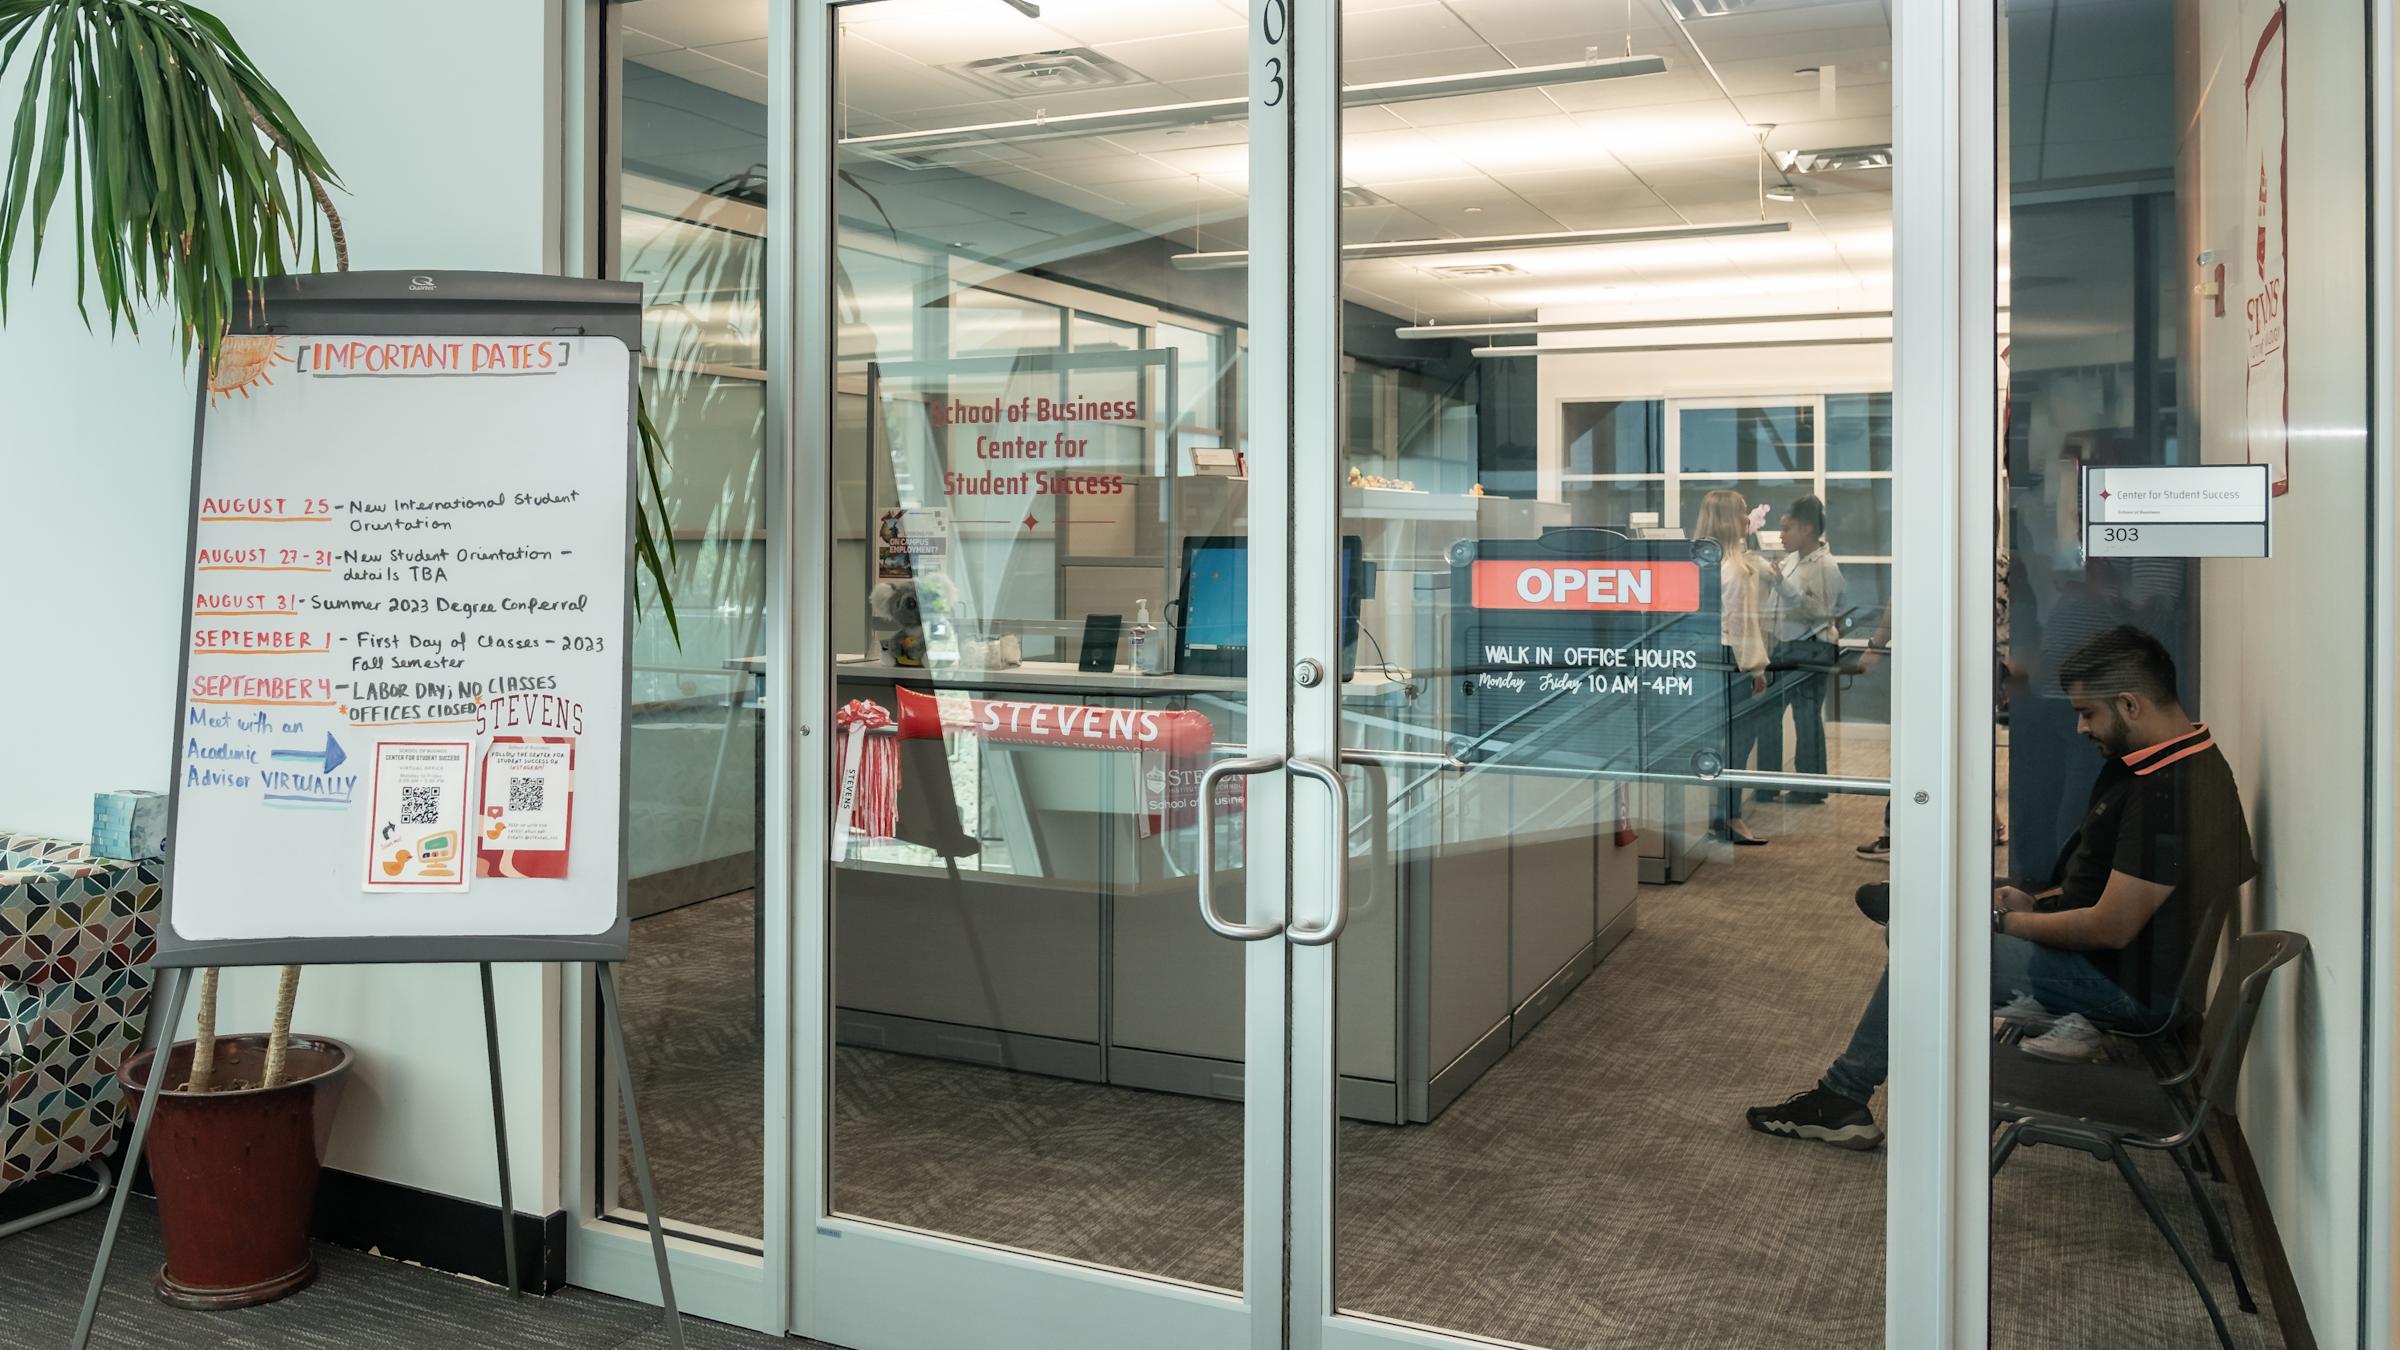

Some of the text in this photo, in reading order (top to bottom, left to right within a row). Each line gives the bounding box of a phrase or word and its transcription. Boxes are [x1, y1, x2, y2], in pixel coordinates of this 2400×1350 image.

[932, 394, 1137, 427] School of Business
[976, 432, 1088, 460] Center for
[943, 470, 1123, 496] Student Success
[2117, 489, 2240, 500] Center for Student Success
[202, 497, 287, 515] AUGUST
[304, 498, 330, 515] 25
[349, 499, 386, 514] New
[394, 491, 505, 512] International
[513, 489, 580, 507] Student
[349, 516, 452, 533] Orientation
[2103, 527, 2139, 542] 303
[197, 548, 267, 565] AUGUST
[343, 549, 382, 564] New
[390, 547, 449, 563] Student
[456, 544, 553, 564] Orientation
[343, 565, 448, 584] details TBA
[1516, 567, 1653, 605] OPEN
[196, 593, 266, 610] AUGUST
[277, 593, 296, 611] 31
[311, 594, 382, 612] Summer
[388, 597, 430, 613] 2023
[436, 596, 498, 619] Degree
[194, 629, 313, 649] SEPTEMBER
[325, 631, 332, 649] 1
[357, 630, 399, 650] First
[409, 634, 442, 655] Day
[450, 631, 466, 652] of
[477, 635, 540, 649] Classes
[561, 635, 605, 653] 2023
[351, 655, 465, 672] Fall Semester
[1484, 645, 1697, 670] WALK IN OFFICE HOURS
[191, 673, 314, 700] SEPTEMBER
[318, 677, 332, 700] 4
[353, 680, 409, 701] LABOR
[458, 680, 483, 699] NO
[1478, 671, 1527, 695] Monday
[1539, 672, 1583, 694] Friday
[189, 706, 304, 734] Meet with an
[476, 693, 583, 736] STEVENS
[982, 702, 1161, 742] STEVENS
[187, 737, 259, 765] Academic
[187, 764, 358, 800] Advisor VIRTUALLY
[843, 768, 856, 810] STEVENS
[1148, 798, 1187, 810] School
